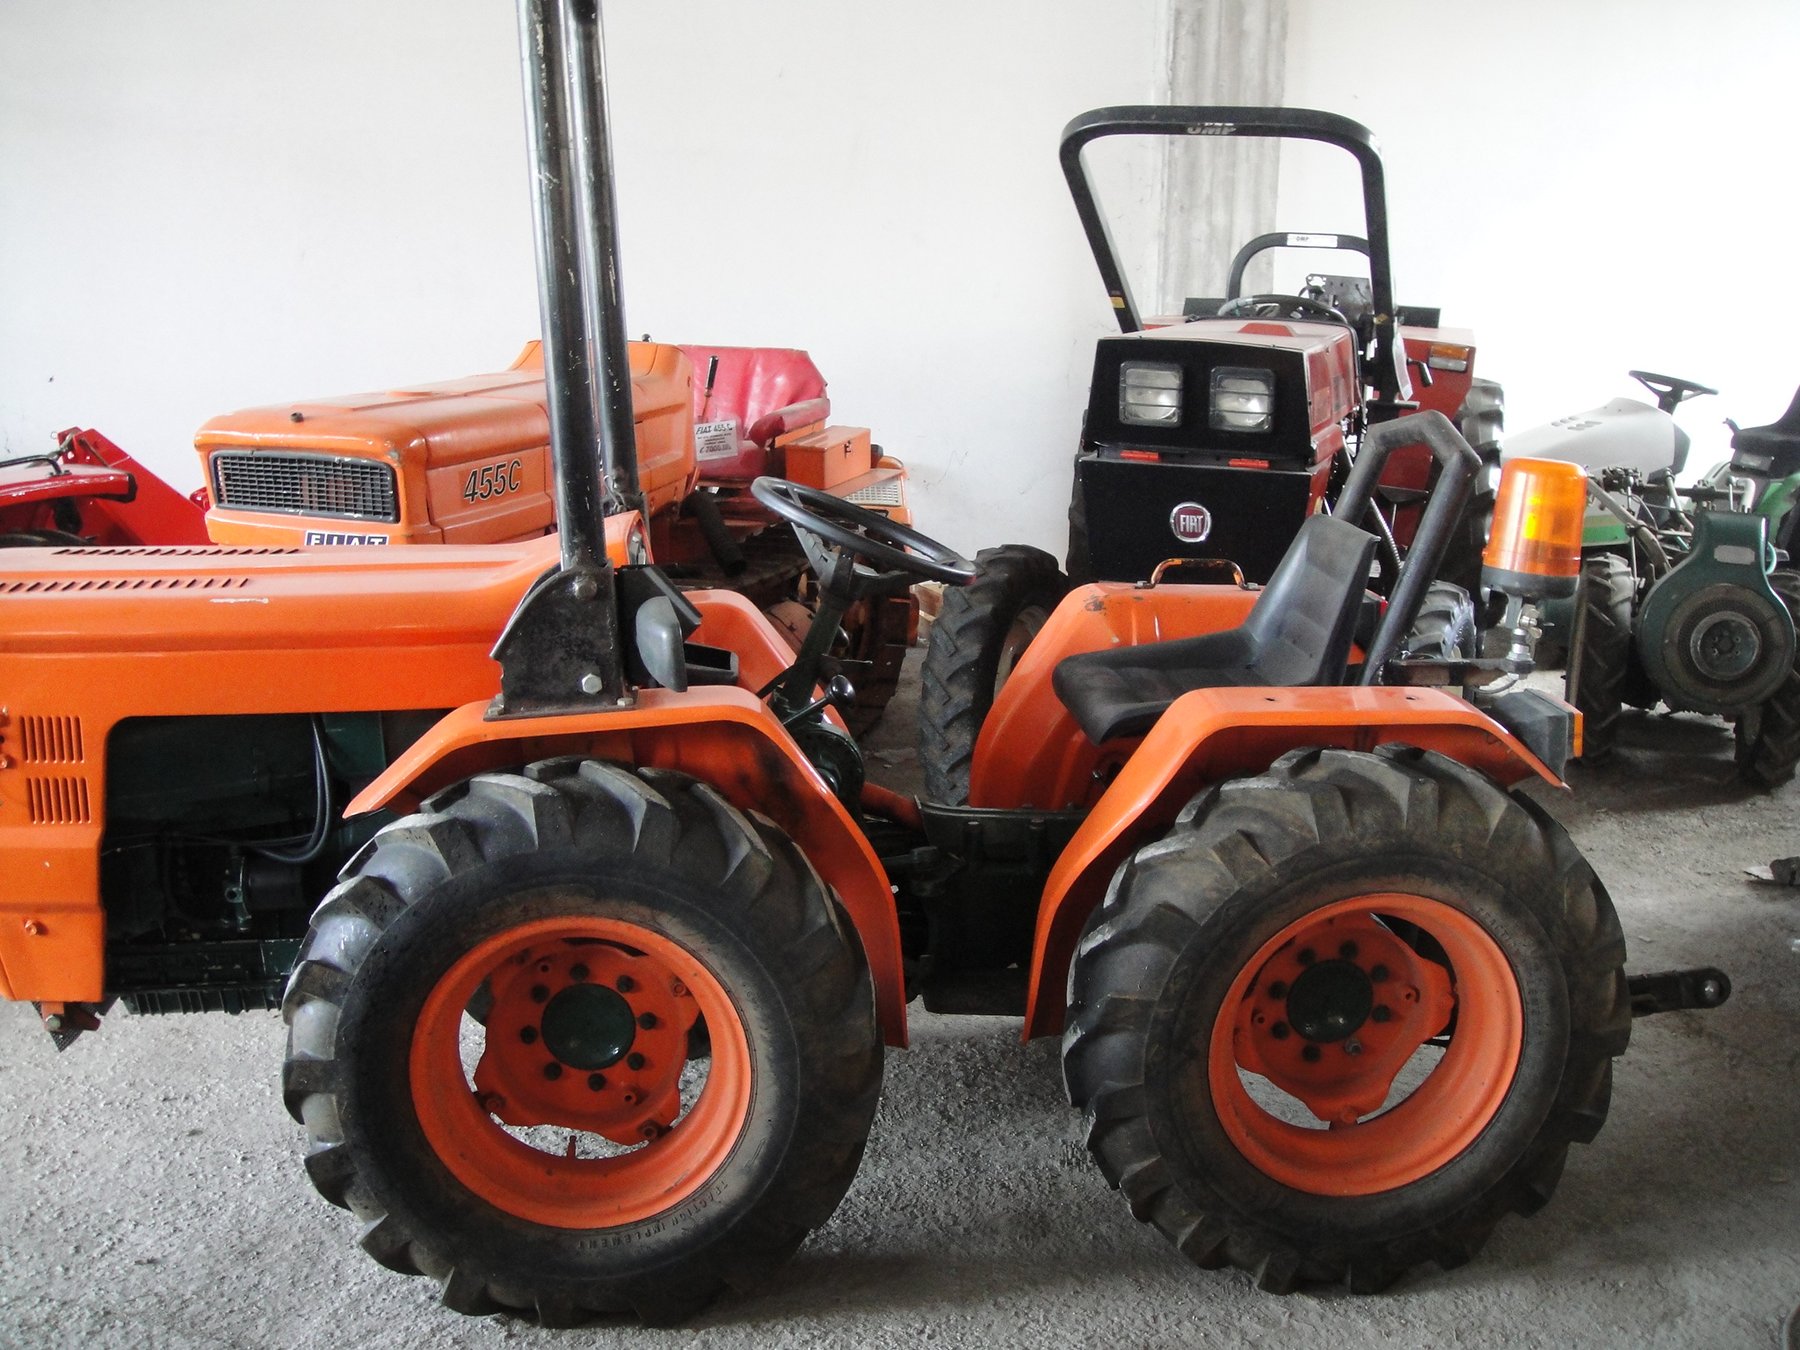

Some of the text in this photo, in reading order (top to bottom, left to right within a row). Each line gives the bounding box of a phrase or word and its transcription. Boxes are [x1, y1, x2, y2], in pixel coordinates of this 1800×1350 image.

[696, 425, 711, 435] FIAT
[463, 459, 522, 503] 455C
[1180, 514, 1204, 533] FIAT
[310, 533, 384, 546] FIAT
[577, 1180, 729, 1249] TRACTION IMPLEMENT
